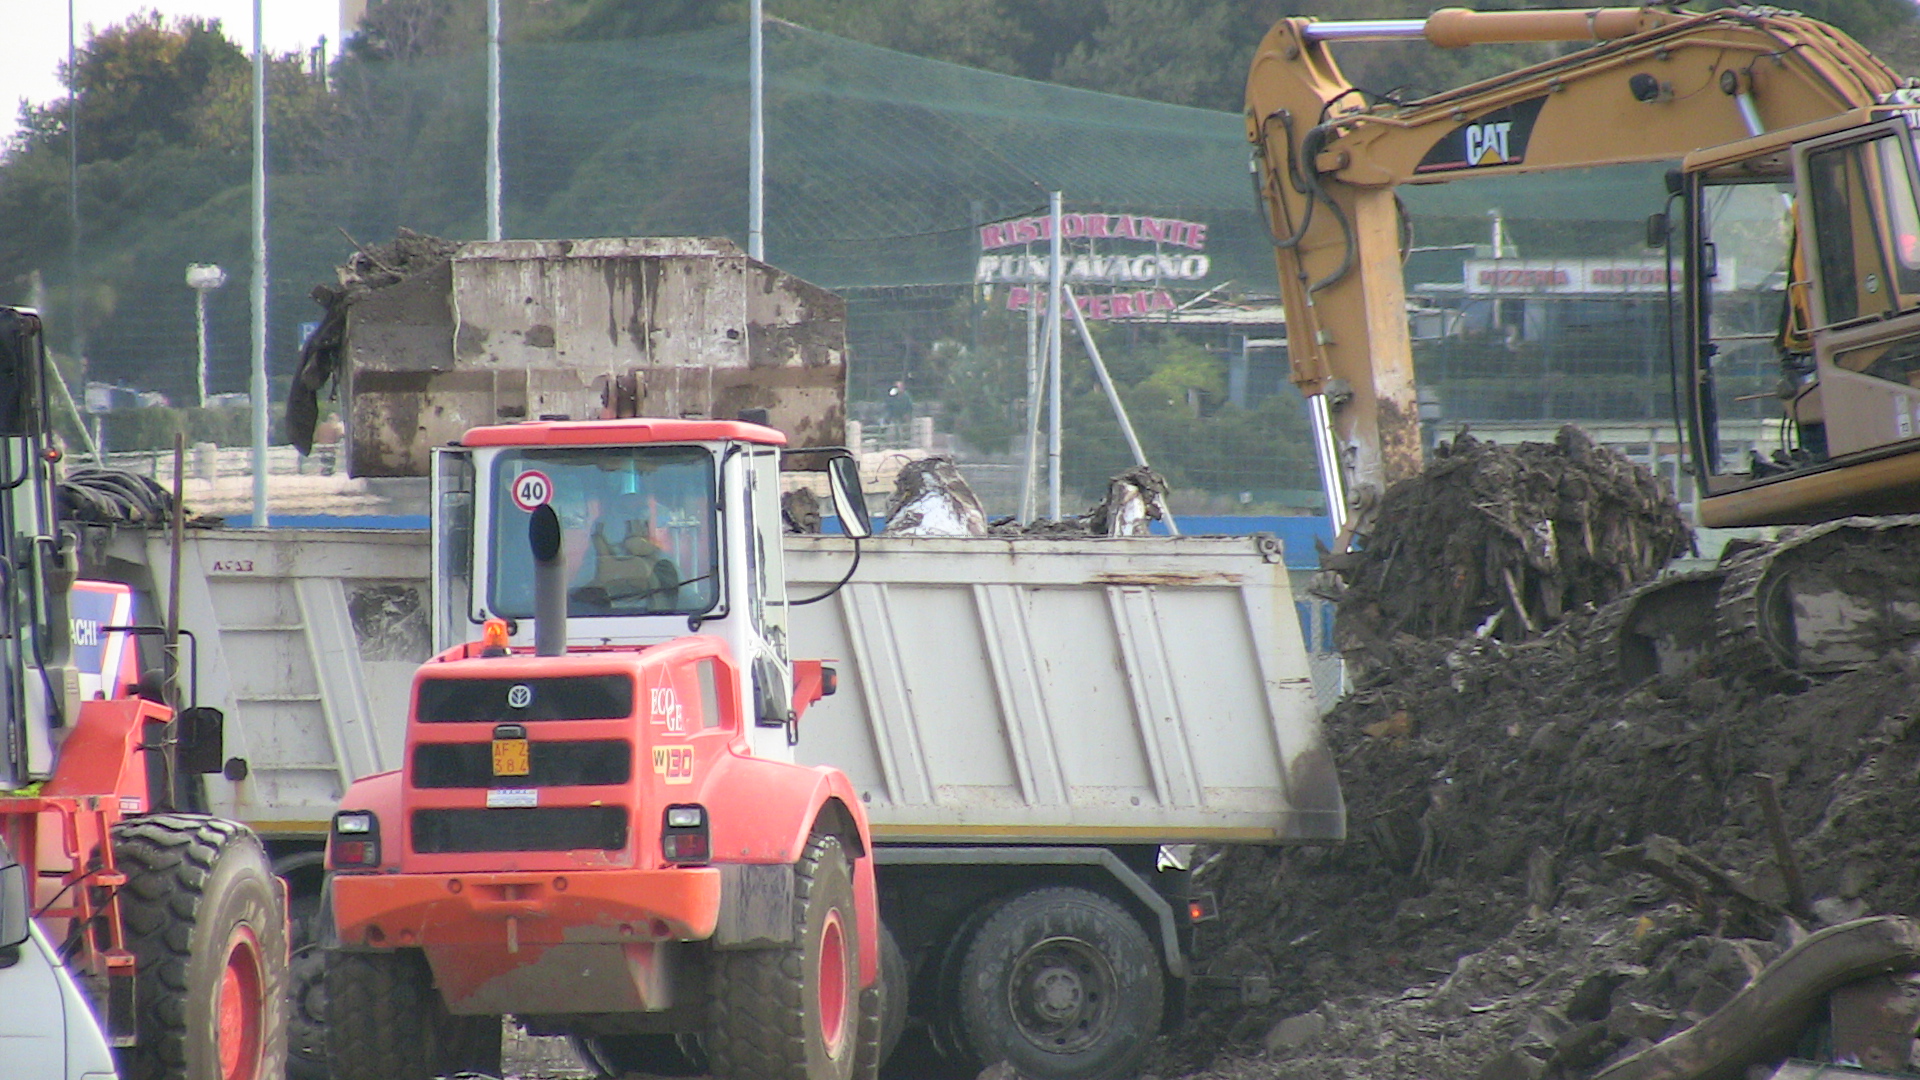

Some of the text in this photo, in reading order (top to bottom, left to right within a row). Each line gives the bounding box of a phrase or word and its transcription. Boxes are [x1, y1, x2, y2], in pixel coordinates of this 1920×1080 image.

[1466, 121, 1513, 166] CAT
[980, 213, 1207, 250] RISTORANTE
[521, 482, 544, 501] 40
[651, 687, 675, 715] ECO
[666, 704, 683, 731] GE
